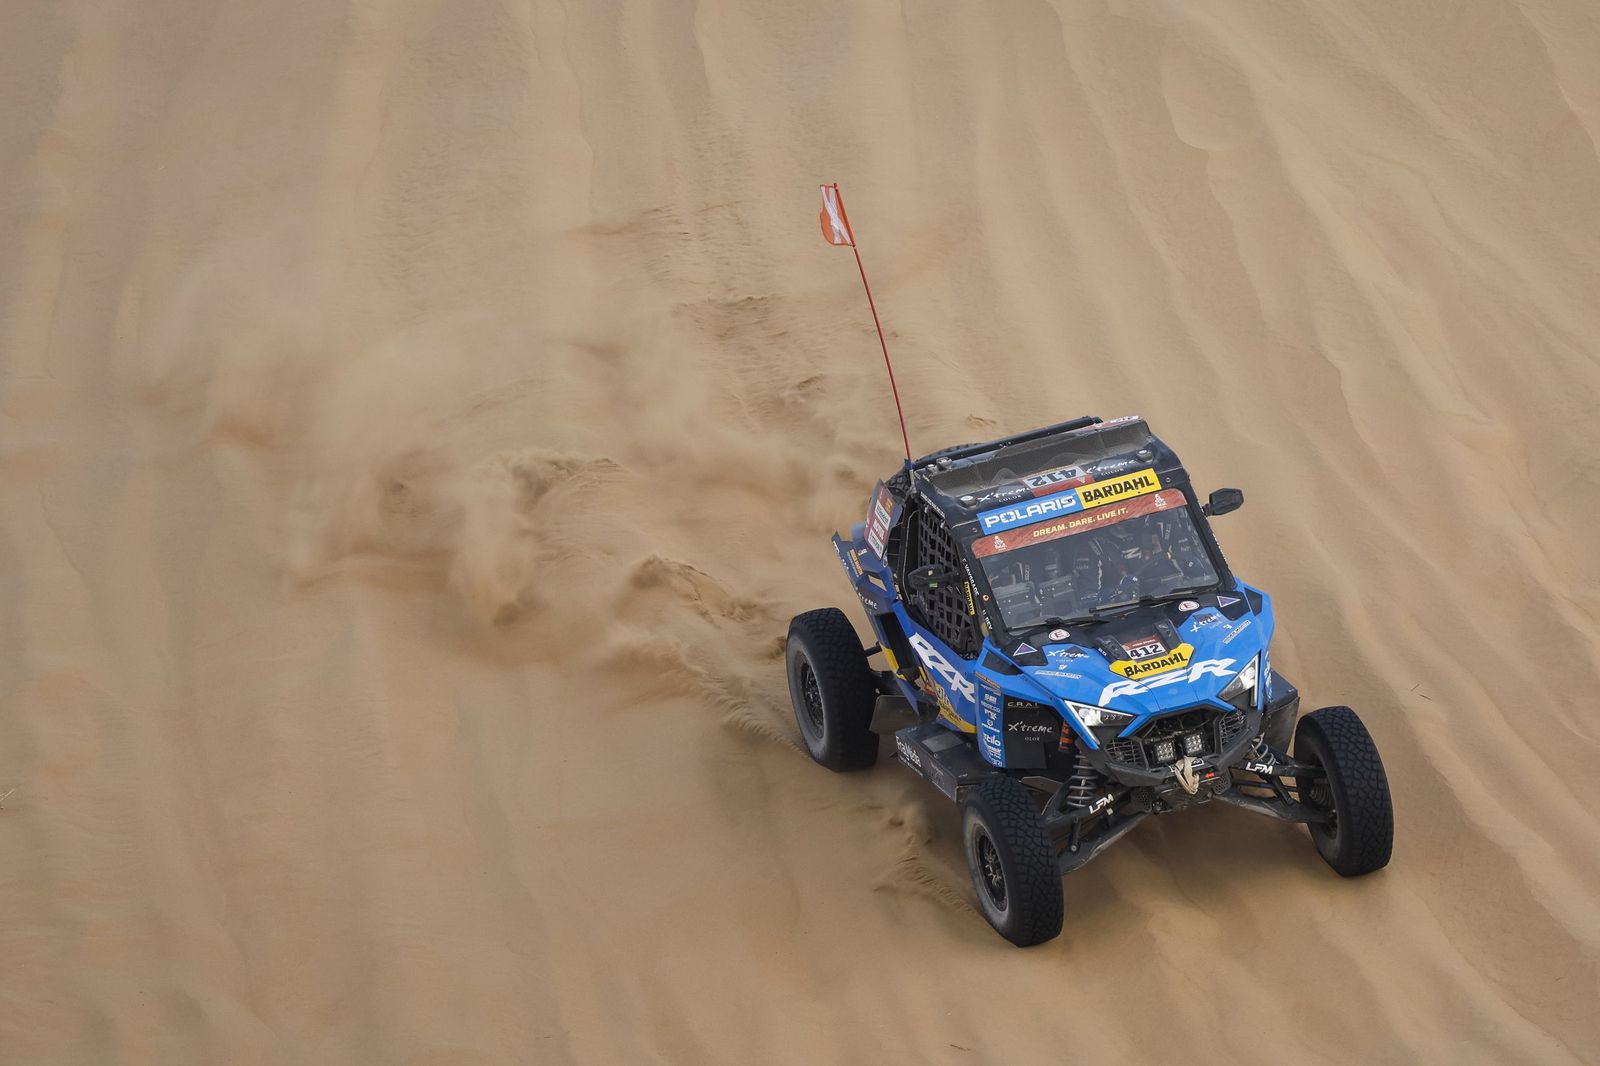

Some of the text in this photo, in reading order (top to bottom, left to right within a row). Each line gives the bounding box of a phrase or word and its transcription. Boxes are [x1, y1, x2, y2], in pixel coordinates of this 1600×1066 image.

[1027, 468, 1077, 487] 412
[1082, 475, 1155, 503] BARDAHL
[983, 494, 1077, 529] POLARIS
[1033, 508, 1129, 538] DREAM. DARE. LIVE IT.
[1130, 644, 1162, 659] 412
[908, 632, 976, 704] RZR
[1123, 652, 1188, 677] BARDAHL
[1097, 658, 1238, 707] RZR
[1008, 720, 1053, 733] X'treme
[1245, 762, 1274, 775] LFM
[1088, 793, 1115, 814] LFM
